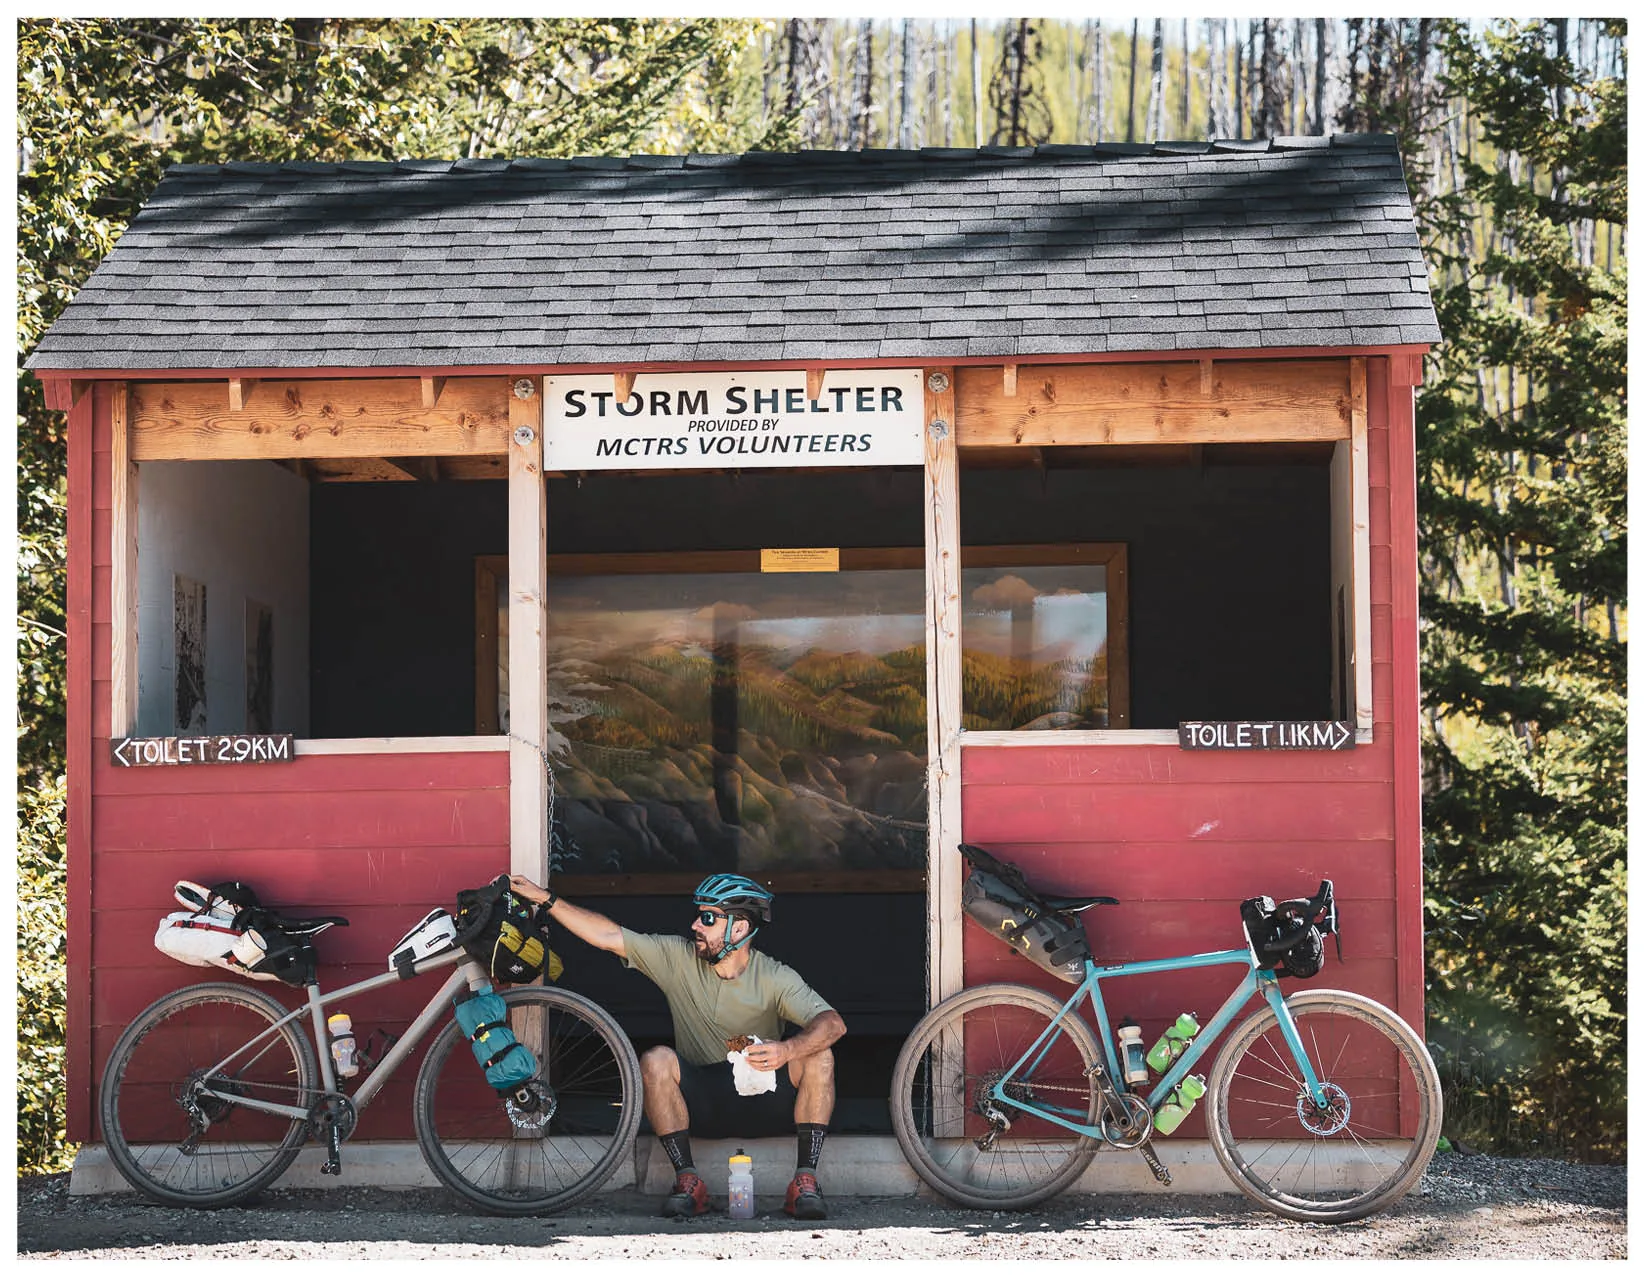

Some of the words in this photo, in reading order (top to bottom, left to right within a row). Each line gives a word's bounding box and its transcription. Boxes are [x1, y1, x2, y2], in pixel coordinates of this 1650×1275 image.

[565, 389, 709, 418] STORM
[688, 419, 758, 433] PROVIDED
[762, 418, 780, 431] BY
[596, 436, 689, 457] MCTRS
[699, 433, 873, 455] VOLUNTEERS
[1185, 723, 1273, 747] TOILET
[130, 738, 210, 764] TOILET
[217, 737, 289, 762] 2.9KM
